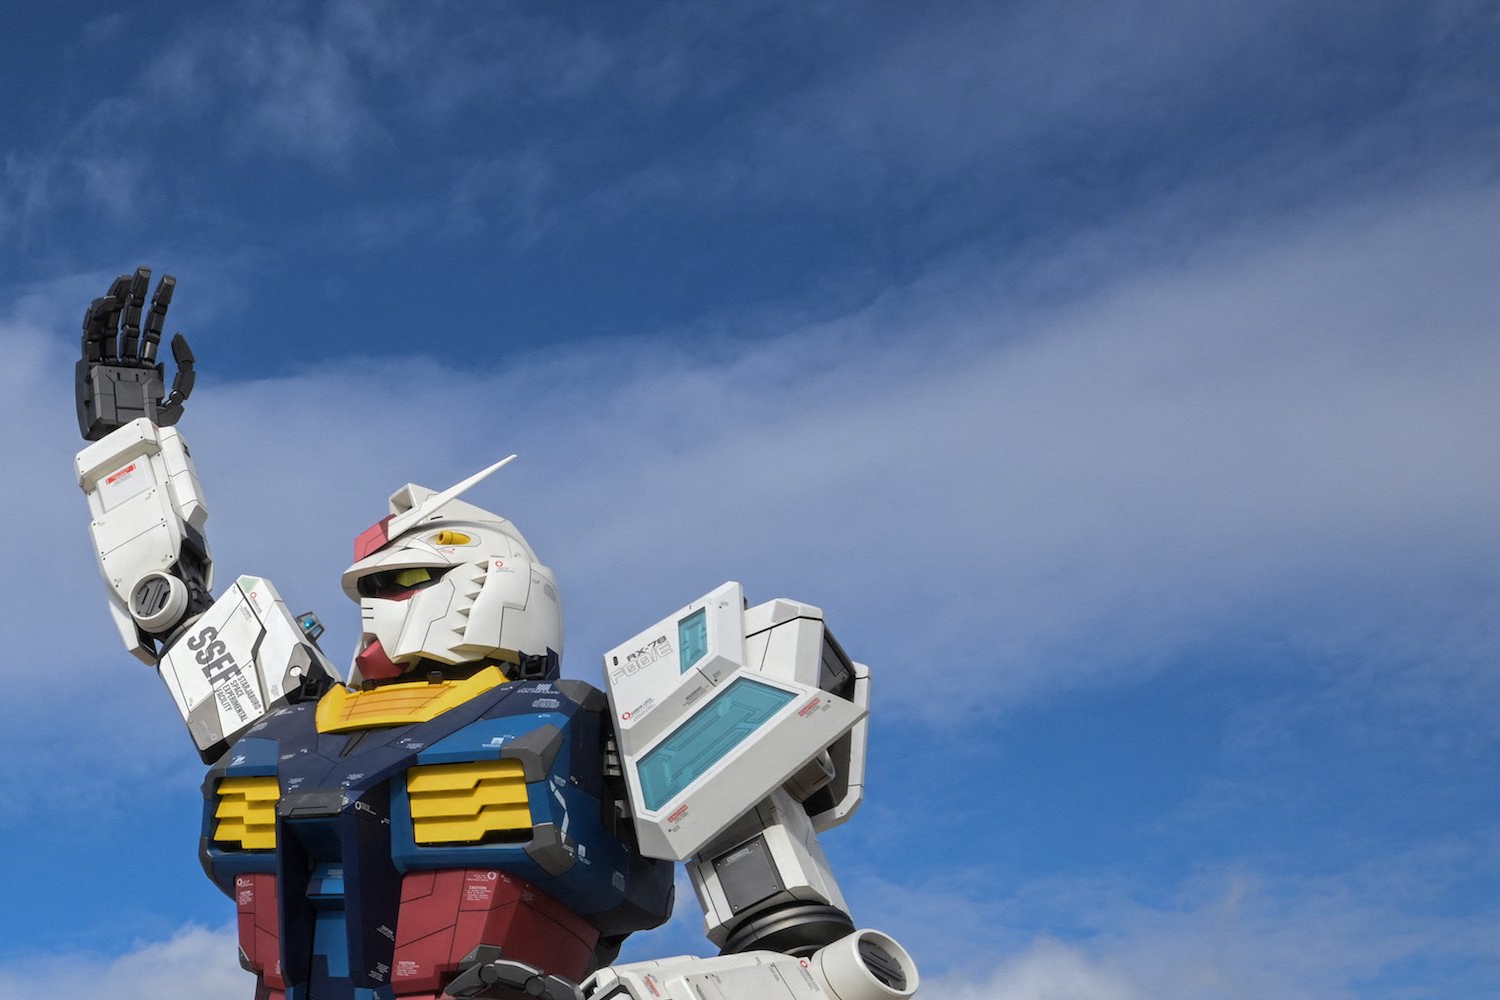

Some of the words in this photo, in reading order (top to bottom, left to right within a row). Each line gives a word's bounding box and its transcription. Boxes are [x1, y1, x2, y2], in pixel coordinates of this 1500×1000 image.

[187, 626, 242, 686] SSEF
[626, 635, 667, 661] RX-78
[215, 688, 233, 712] FACILITY
[230, 679, 245, 698] SPACE
[222, 684, 248, 723] EXPERIMENTAL
